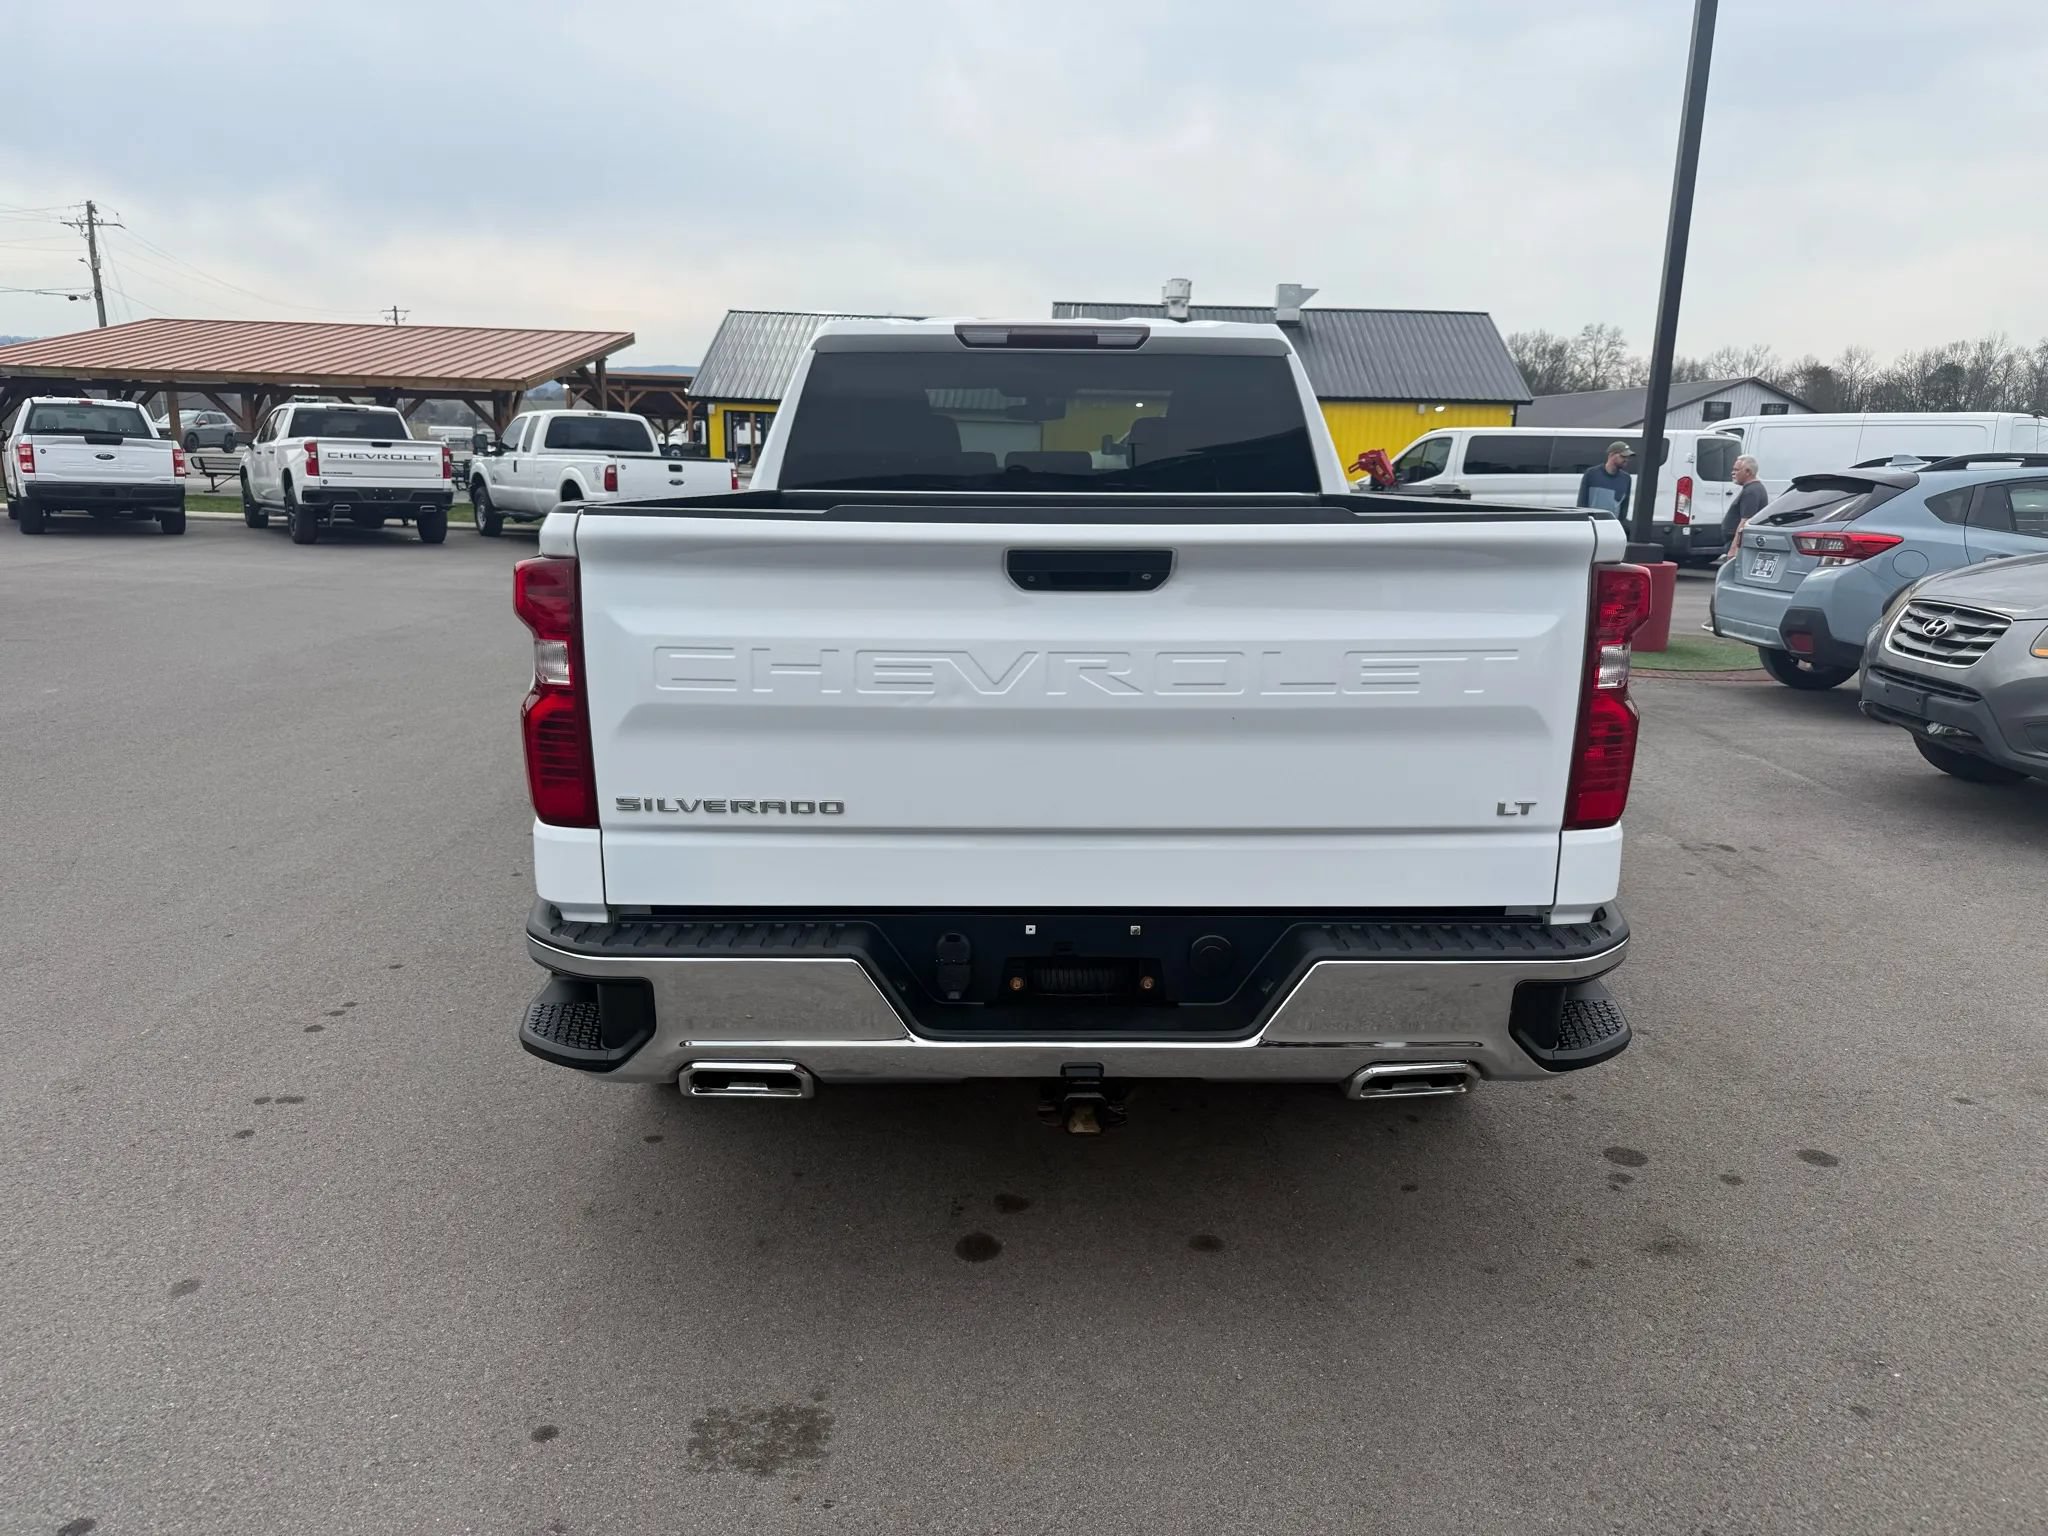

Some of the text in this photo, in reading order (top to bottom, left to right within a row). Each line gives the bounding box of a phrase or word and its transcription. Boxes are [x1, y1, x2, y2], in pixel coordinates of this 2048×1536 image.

[327, 452, 434, 461] CHEVROLET
[653, 645, 1519, 696] CHEVROLET
[615, 797, 845, 814] SILVERADO
[1496, 801, 1537, 816] LT
